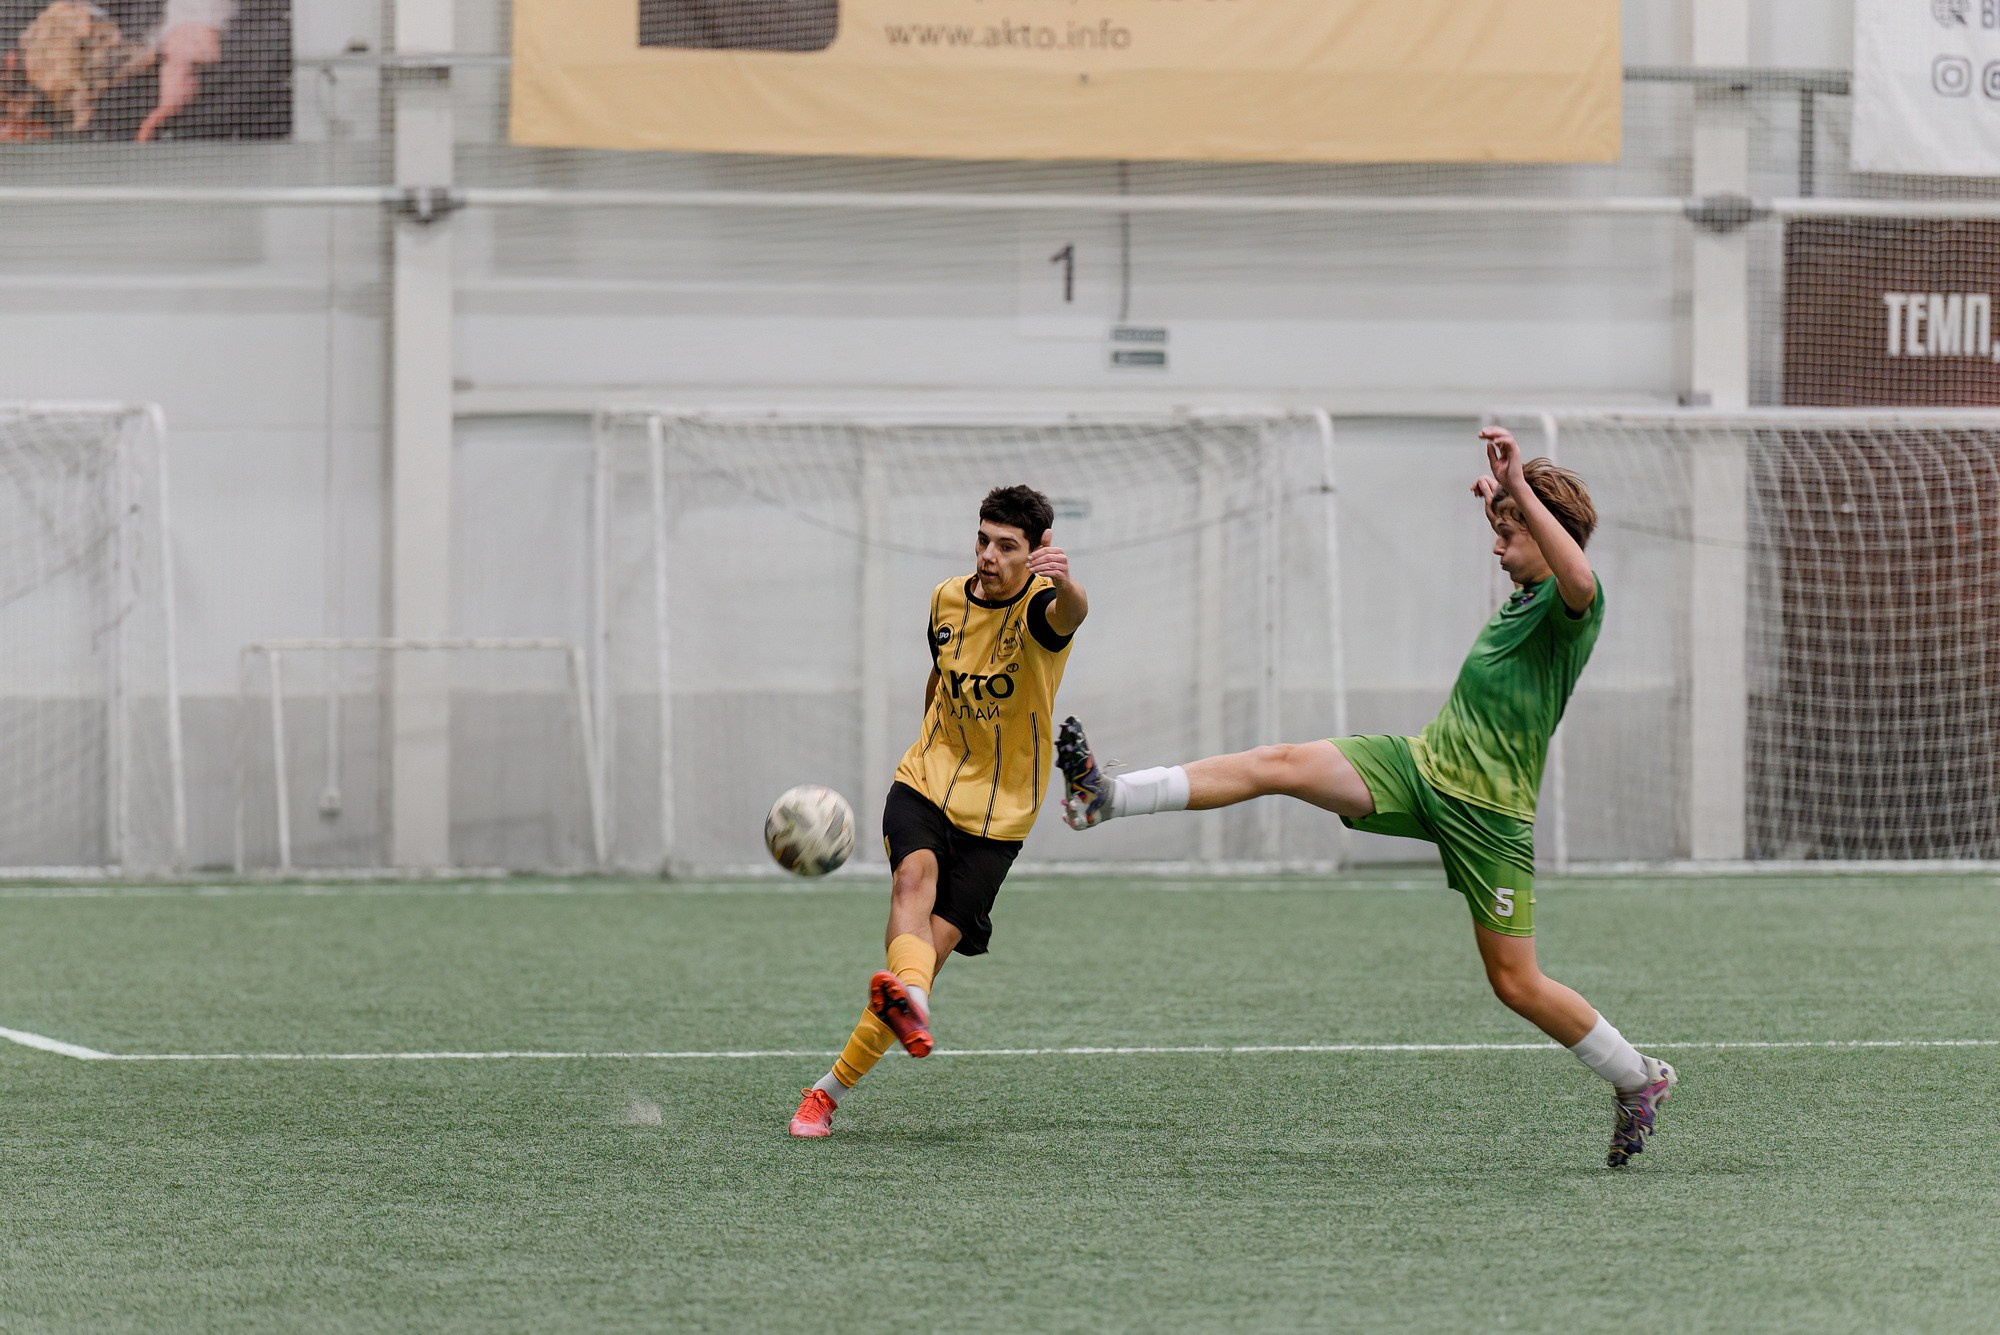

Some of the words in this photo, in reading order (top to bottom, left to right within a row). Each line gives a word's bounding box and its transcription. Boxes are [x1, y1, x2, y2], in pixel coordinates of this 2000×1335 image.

[884, 18, 1132, 50] www.akto.info
[1049, 244, 1074, 303] 1
[944, 669, 1015, 701] КТО
[950, 701, 1000, 721] АЛАЙ
[1494, 887, 1515, 917] 5
